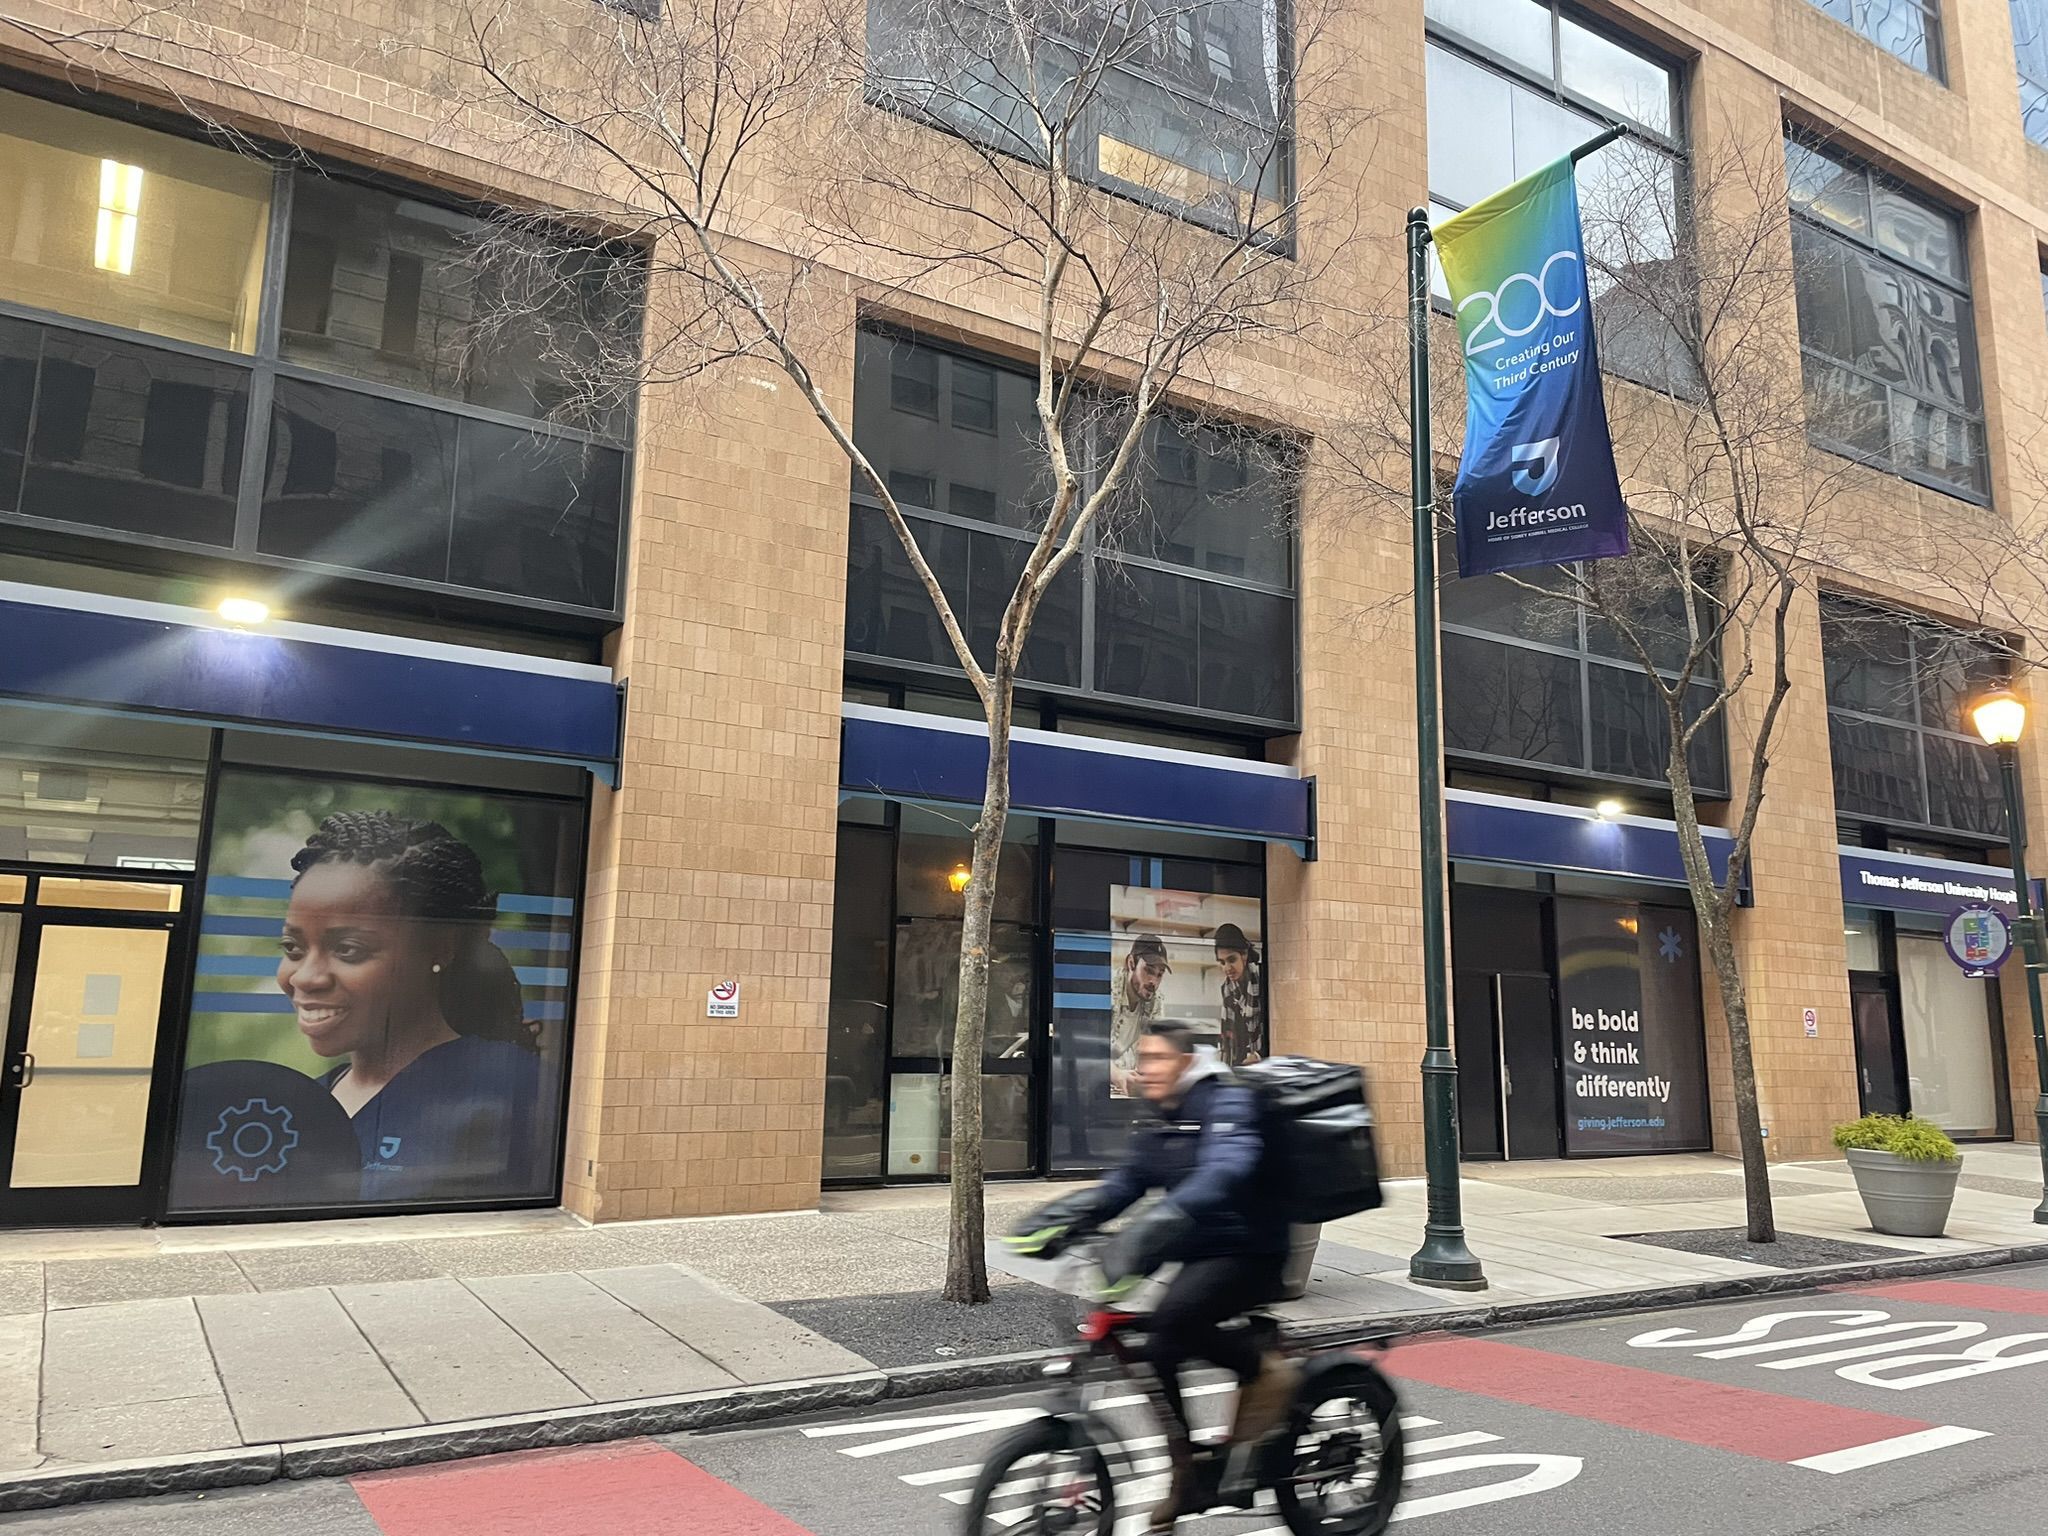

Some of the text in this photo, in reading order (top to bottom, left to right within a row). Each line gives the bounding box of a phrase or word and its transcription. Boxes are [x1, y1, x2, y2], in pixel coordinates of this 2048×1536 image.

[1495, 330, 1575, 370] Creating Our
[1494, 349, 1580, 390] Third Century
[1486, 503, 1587, 531] Jefferson
[1859, 870, 2019, 905] Thomas Jefferson University Hospit
[1571, 1007, 1639, 1032] be bold
[1573, 1040, 1640, 1065] & think
[1576, 1074, 1671, 1103] differently
[1577, 1115, 1665, 1131] giving.jefferson.edu
